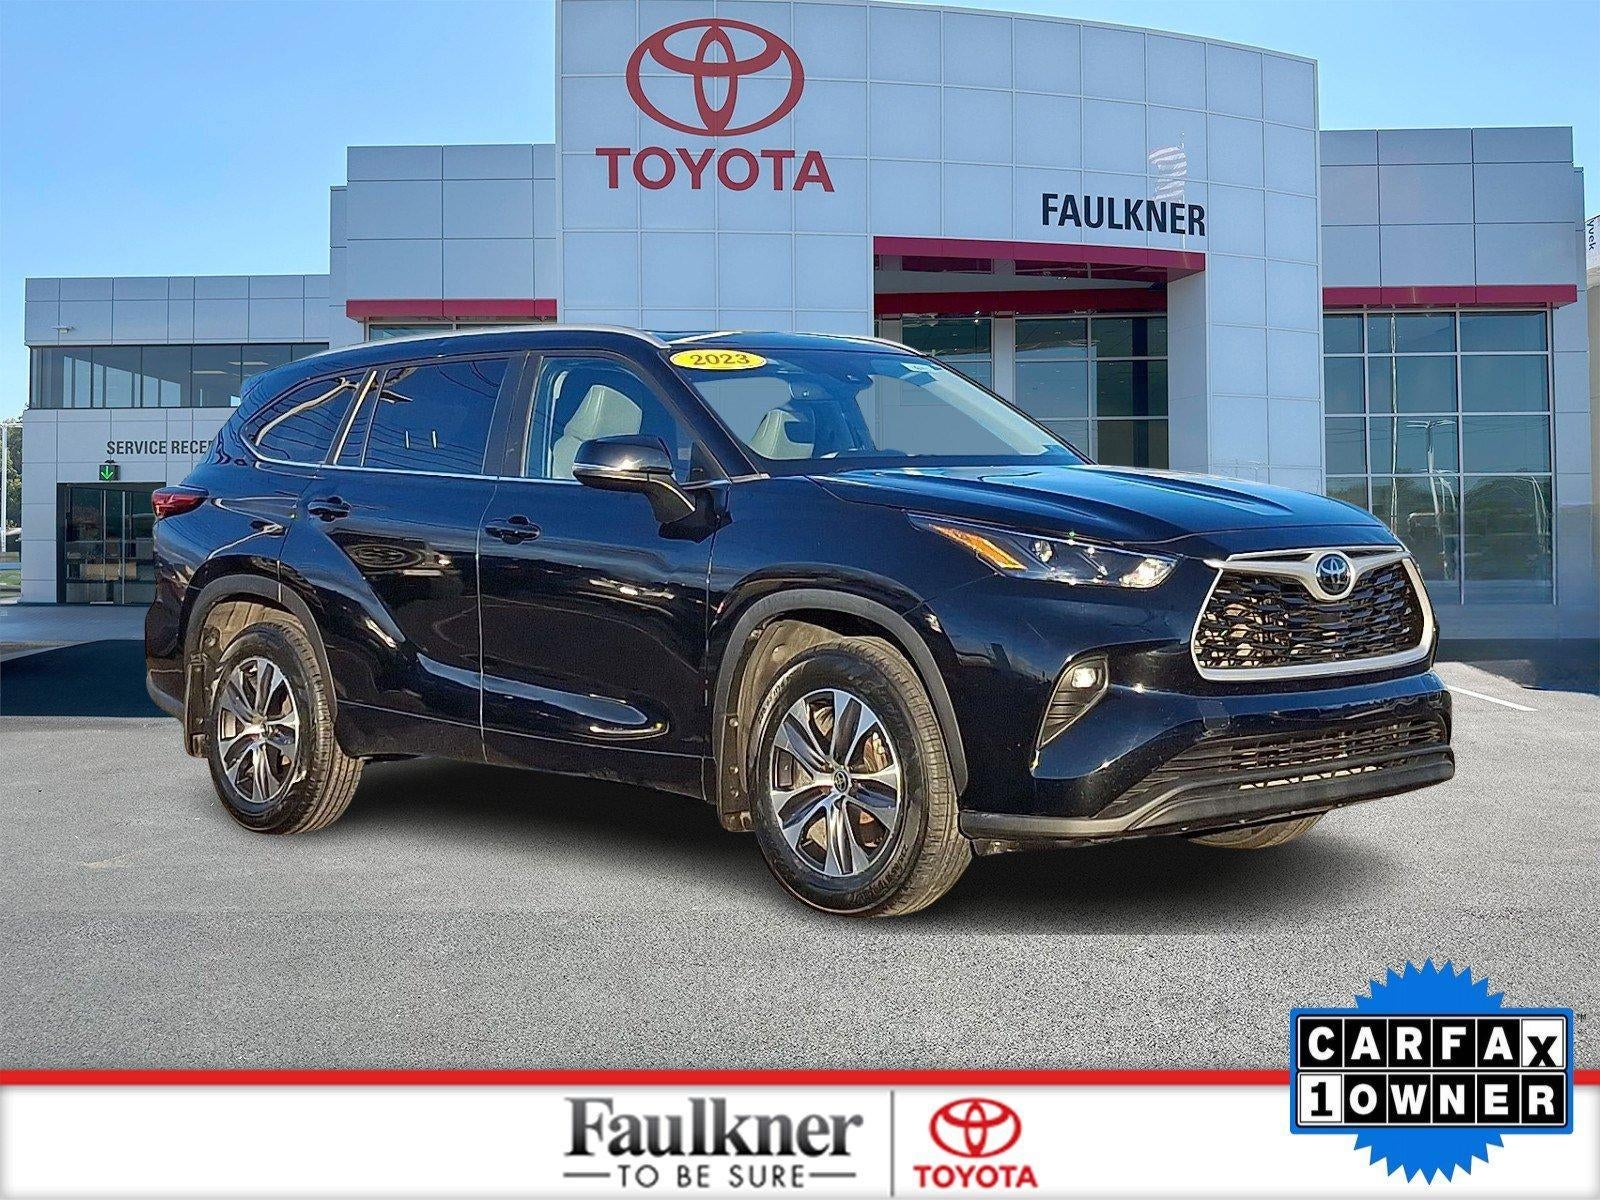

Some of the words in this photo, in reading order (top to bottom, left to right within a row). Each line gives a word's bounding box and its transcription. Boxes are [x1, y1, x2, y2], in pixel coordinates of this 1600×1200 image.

[595, 146, 835, 193] TOYOTA
[1041, 193, 1206, 237] FAULKNER
[1587, 219, 1597, 250] yvek
[690, 353, 750, 366] 2023
[106, 440, 167, 455] SERVICE
